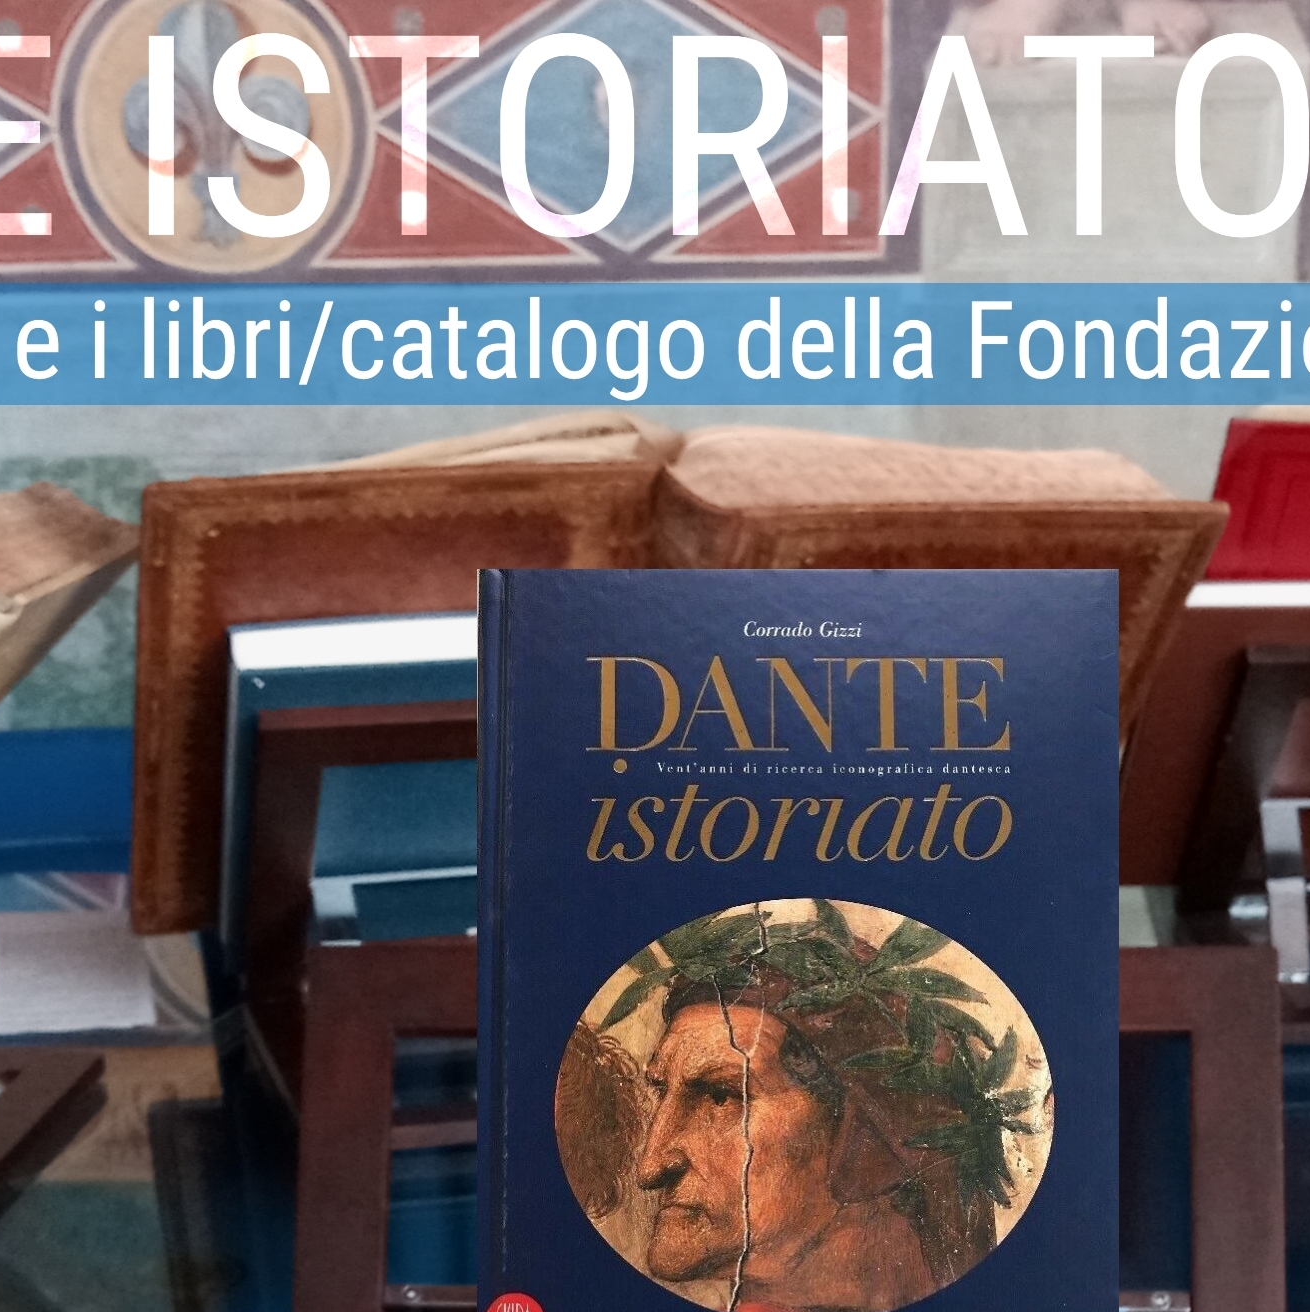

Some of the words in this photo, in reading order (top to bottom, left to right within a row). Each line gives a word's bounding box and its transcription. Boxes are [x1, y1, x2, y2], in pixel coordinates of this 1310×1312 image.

[743, 620, 813, 638] Corrado
[819, 621, 862, 638] Gizzi
[586, 655, 1011, 752] DANTE
[657, 762, 734, 775] Vent'anni
[743, 762, 757, 774] di
[766, 763, 823, 775] ricerca
[833, 762, 933, 777] iconografica
[942, 762, 1012, 775] dantesca
[587, 784, 1013, 862] istoriato
